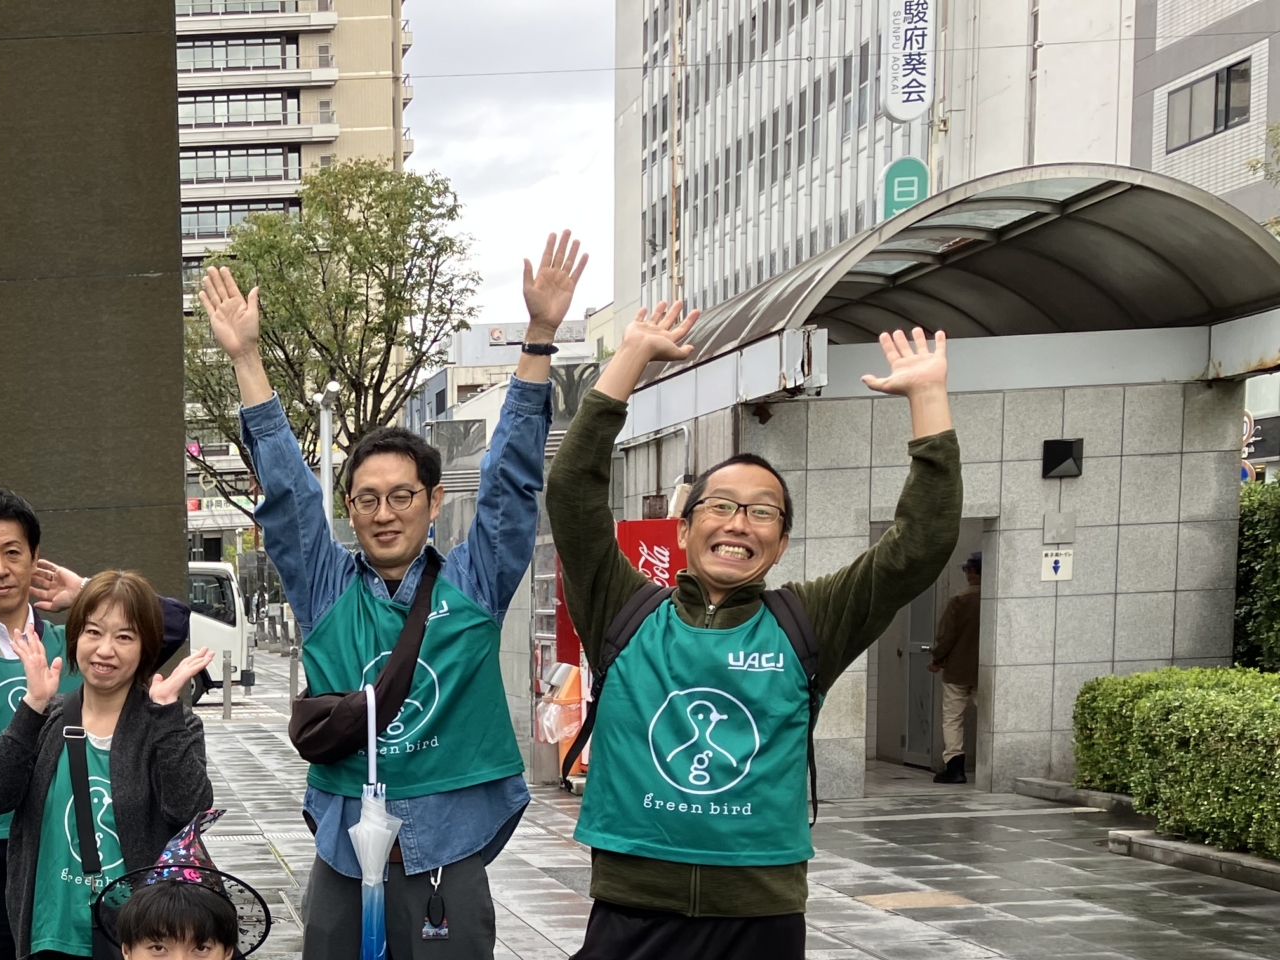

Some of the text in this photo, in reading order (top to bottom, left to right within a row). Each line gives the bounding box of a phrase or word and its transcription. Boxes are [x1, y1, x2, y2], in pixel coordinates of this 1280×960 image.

[890, 10, 901, 95] SUNPU AOIKAI
[901, 0, 929, 103] 駿府葵会
[728, 651, 784, 672] UACJ
[405, 736, 440, 754] bird
[643, 792, 753, 815] green bird
